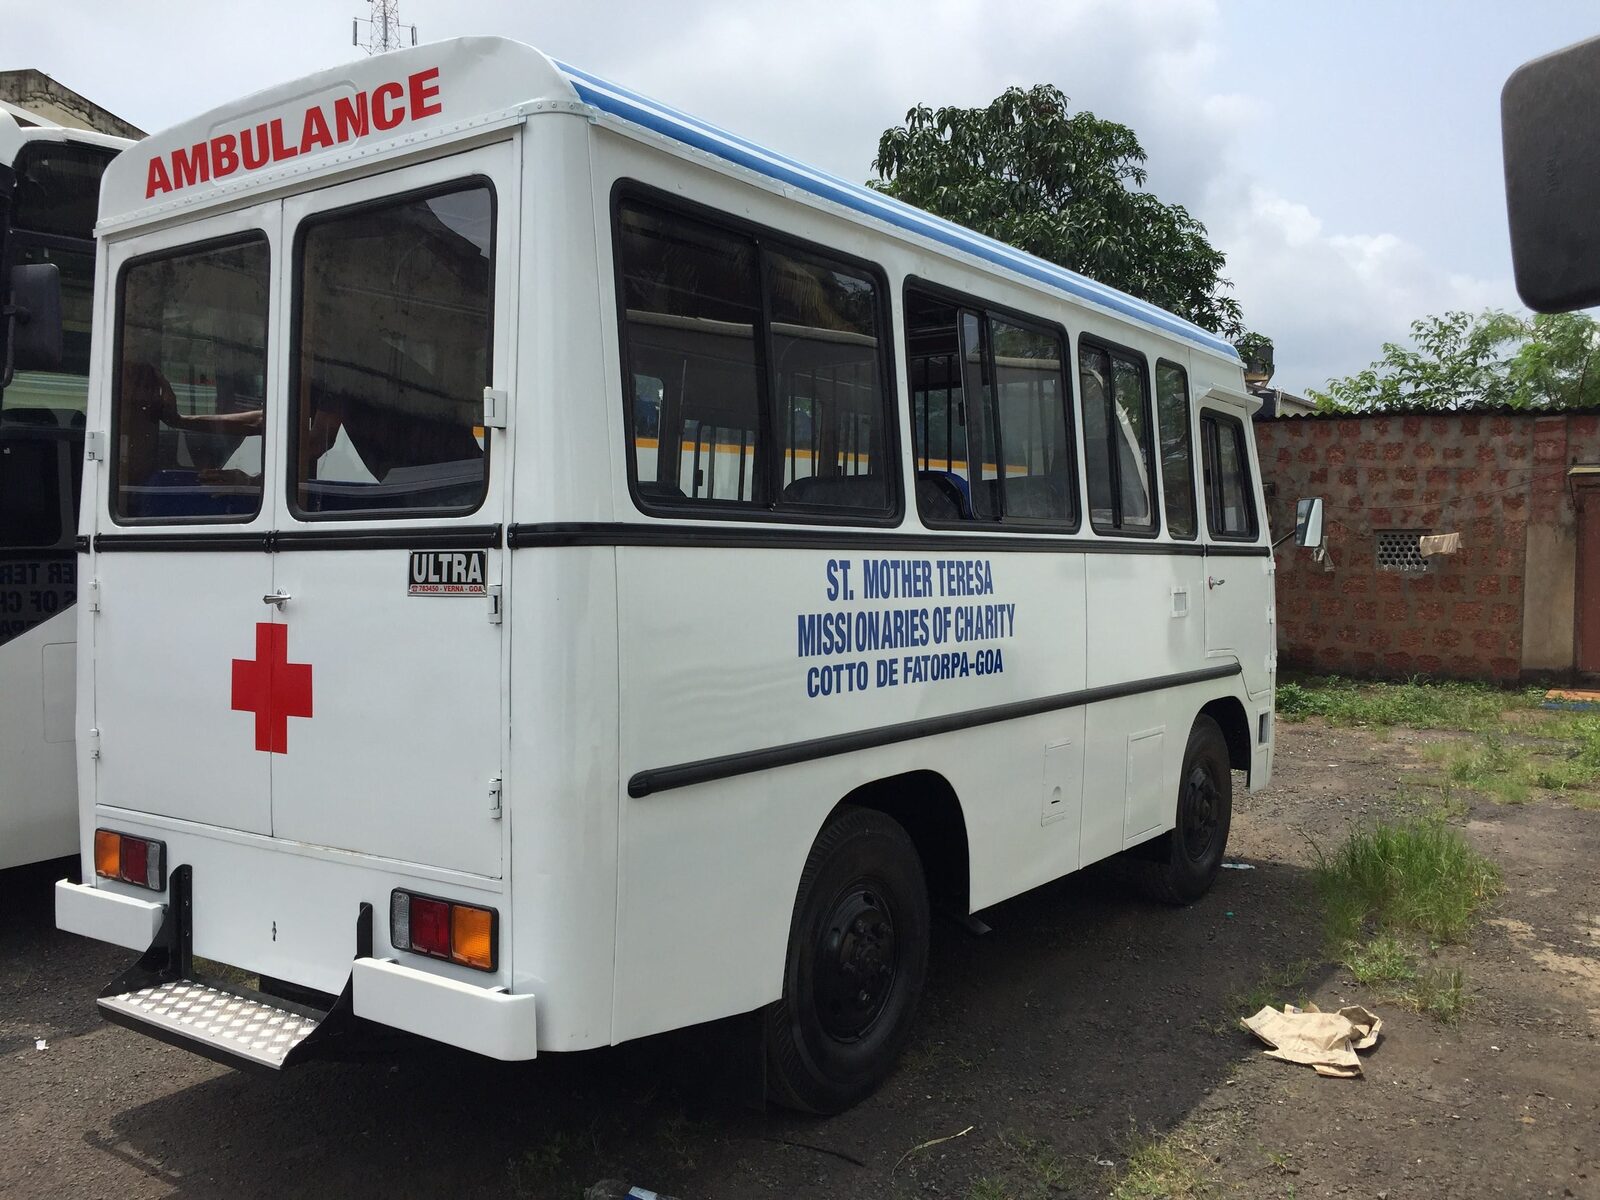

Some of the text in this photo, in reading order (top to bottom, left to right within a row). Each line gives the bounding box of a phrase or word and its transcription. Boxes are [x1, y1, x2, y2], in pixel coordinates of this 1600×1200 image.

[145, 67, 442, 199] AMBULANCE
[413, 553, 483, 583] ULTRA
[826, 558, 994, 602] ST. MOTHER TERESA
[797, 603, 1016, 657] MISSIONARIES OF CHARITY
[807, 648, 1004, 698] COTTO DE FATORPA-GOA
